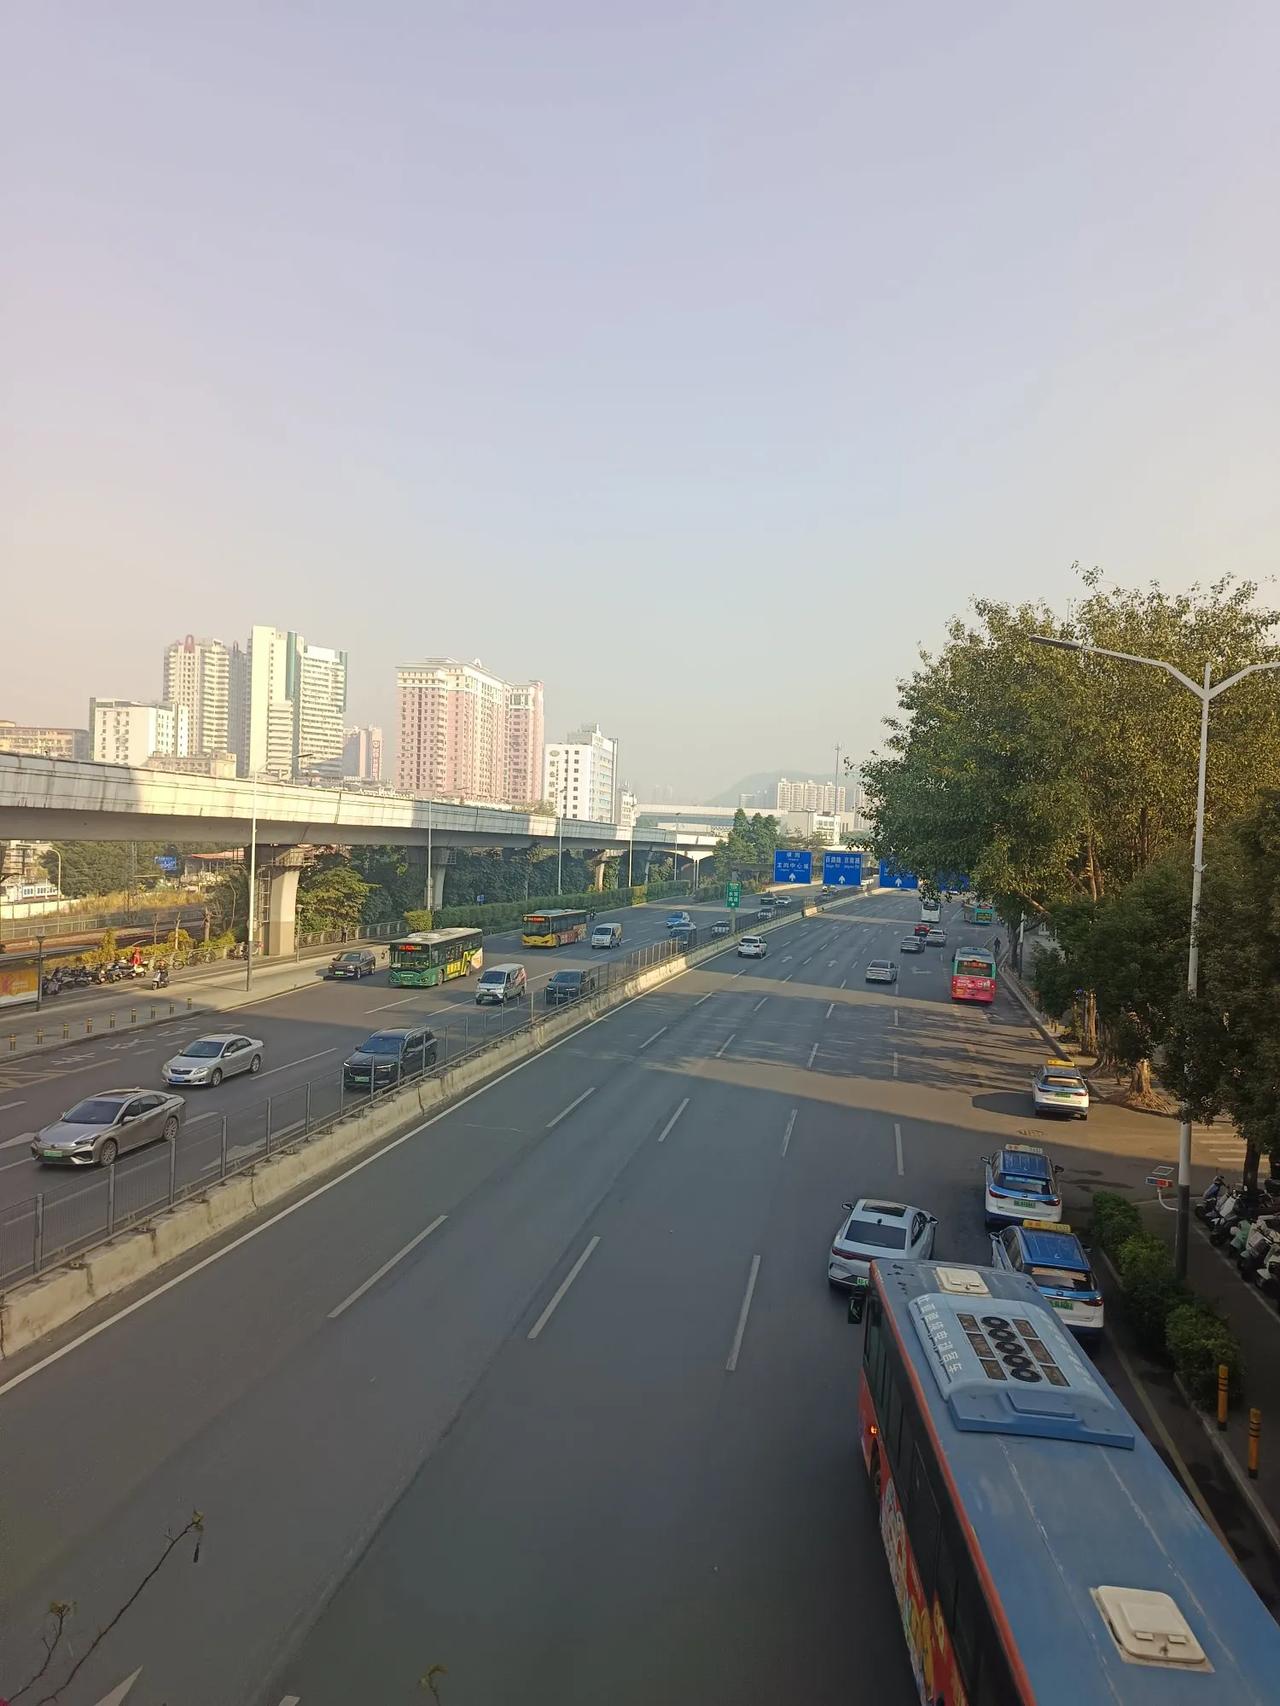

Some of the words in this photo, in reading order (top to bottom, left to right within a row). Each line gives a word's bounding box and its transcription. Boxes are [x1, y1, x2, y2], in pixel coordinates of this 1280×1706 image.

[916, 1293, 963, 1375] 比亚迪纯电动客车
